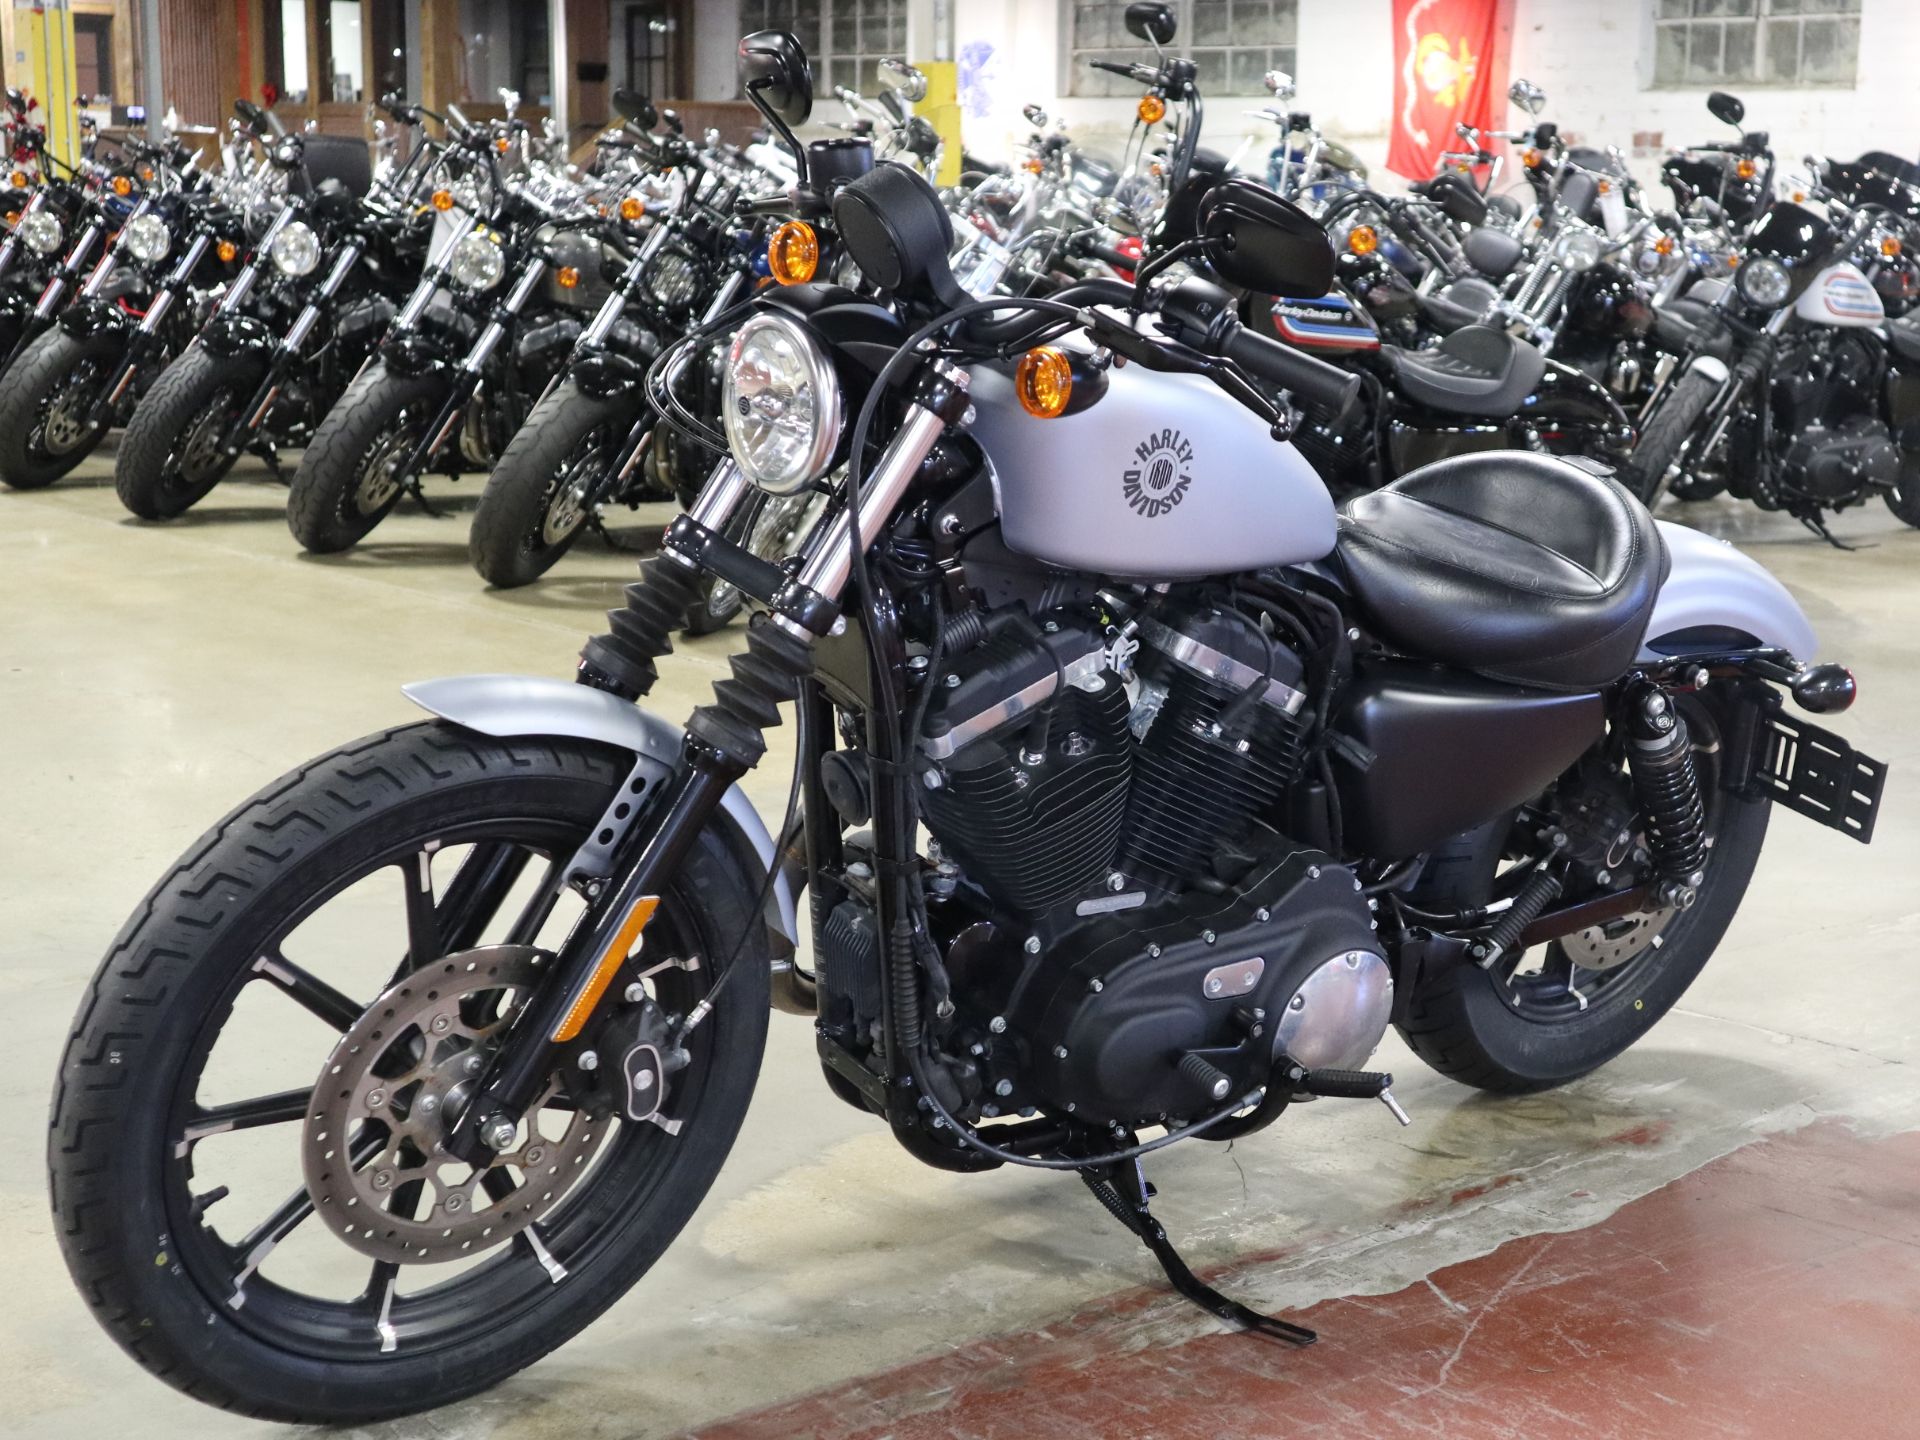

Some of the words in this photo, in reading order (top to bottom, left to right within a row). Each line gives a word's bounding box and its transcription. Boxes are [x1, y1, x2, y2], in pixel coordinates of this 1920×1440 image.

[1135, 428, 1193, 464] HARLEY
[1148, 459, 1173, 490] IRON
[1123, 470, 1192, 518] DAVIDSON
